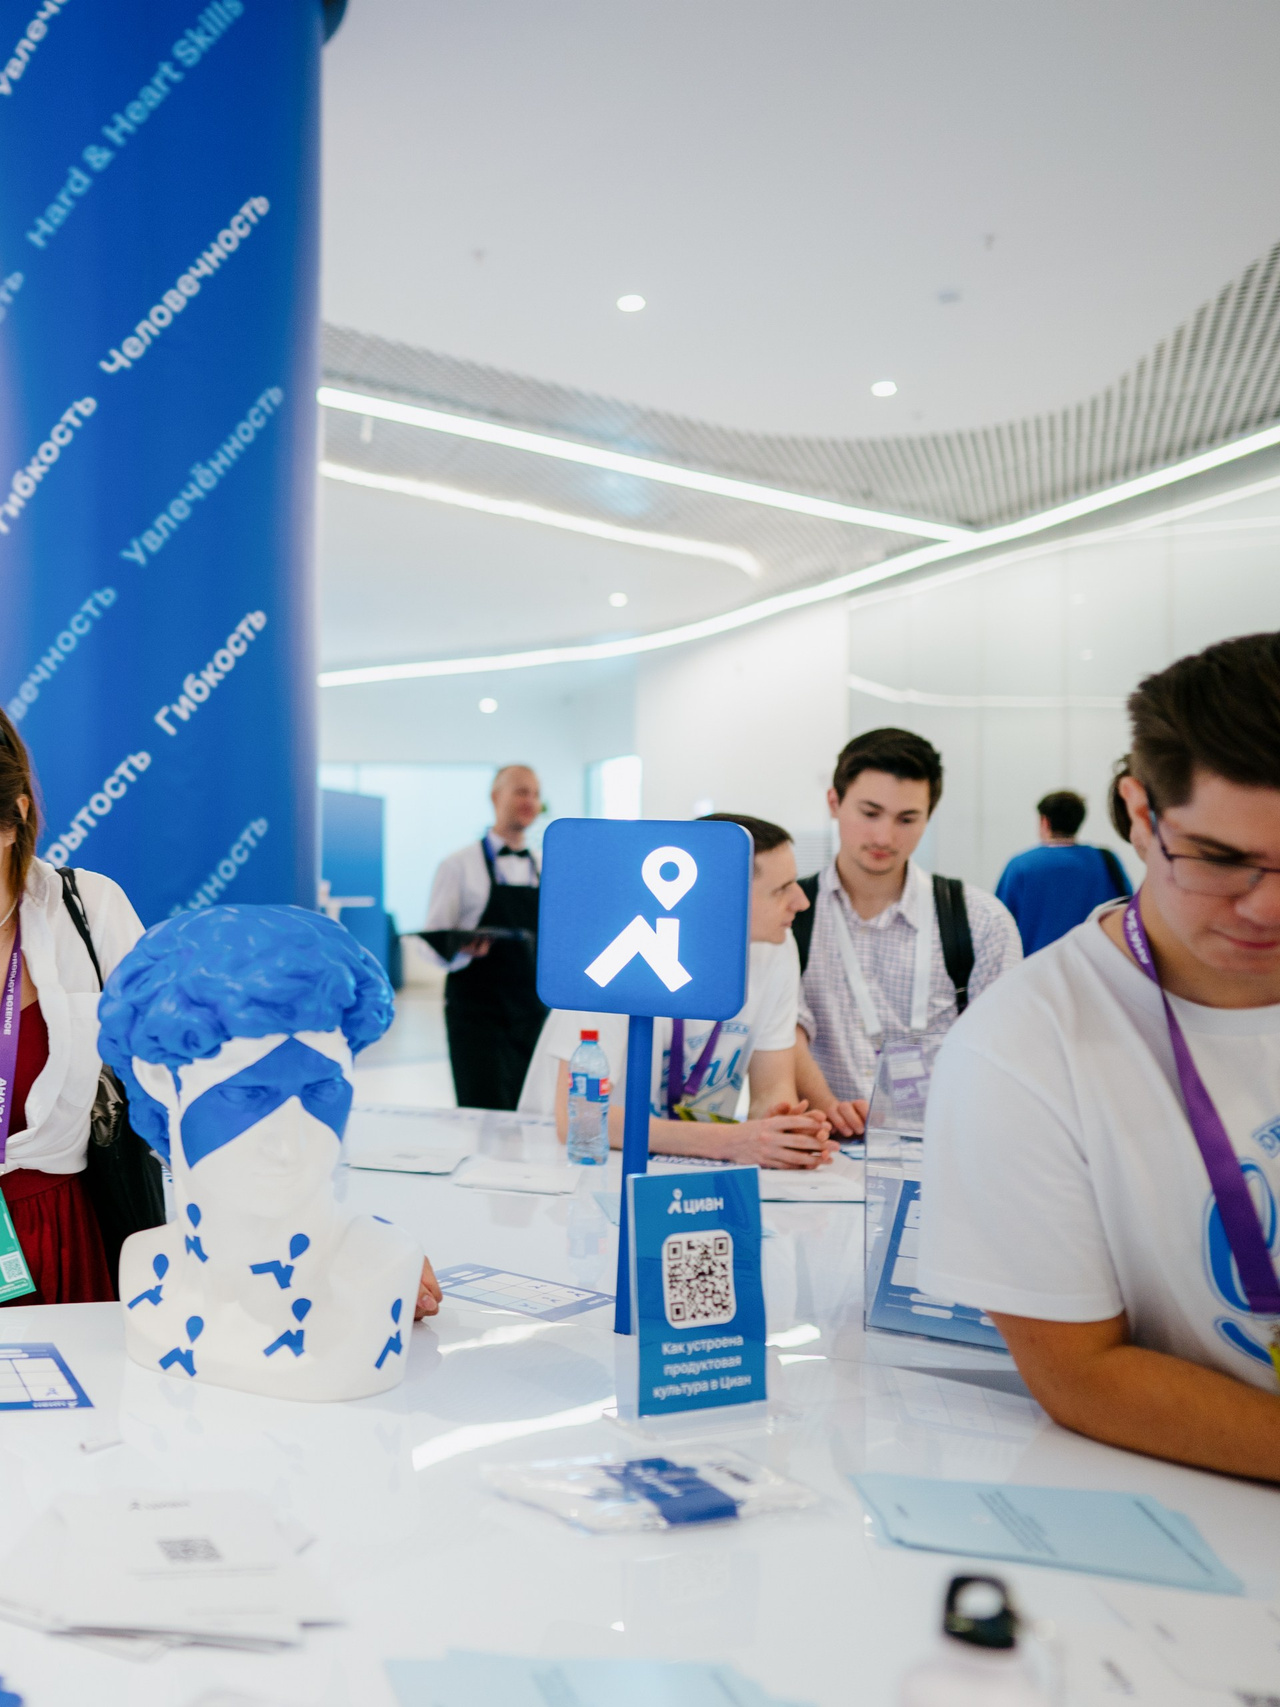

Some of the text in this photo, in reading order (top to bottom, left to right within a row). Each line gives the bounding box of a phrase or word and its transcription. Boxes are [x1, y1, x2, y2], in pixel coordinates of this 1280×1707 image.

[25, 0, 244, 249] Hard & Heart Skills
[99, 195, 270, 374] Человечность
[120, 386, 283, 568] Увлечённость
[7, 587, 117, 723] вечность
[154, 609, 267, 736] Гибкость
[42, 751, 152, 869] рытость
[652, 1380, 710, 1401] культура
[661, 1335, 744, 1356] Как устроена
[663, 1355, 742, 1378] продуктовая
